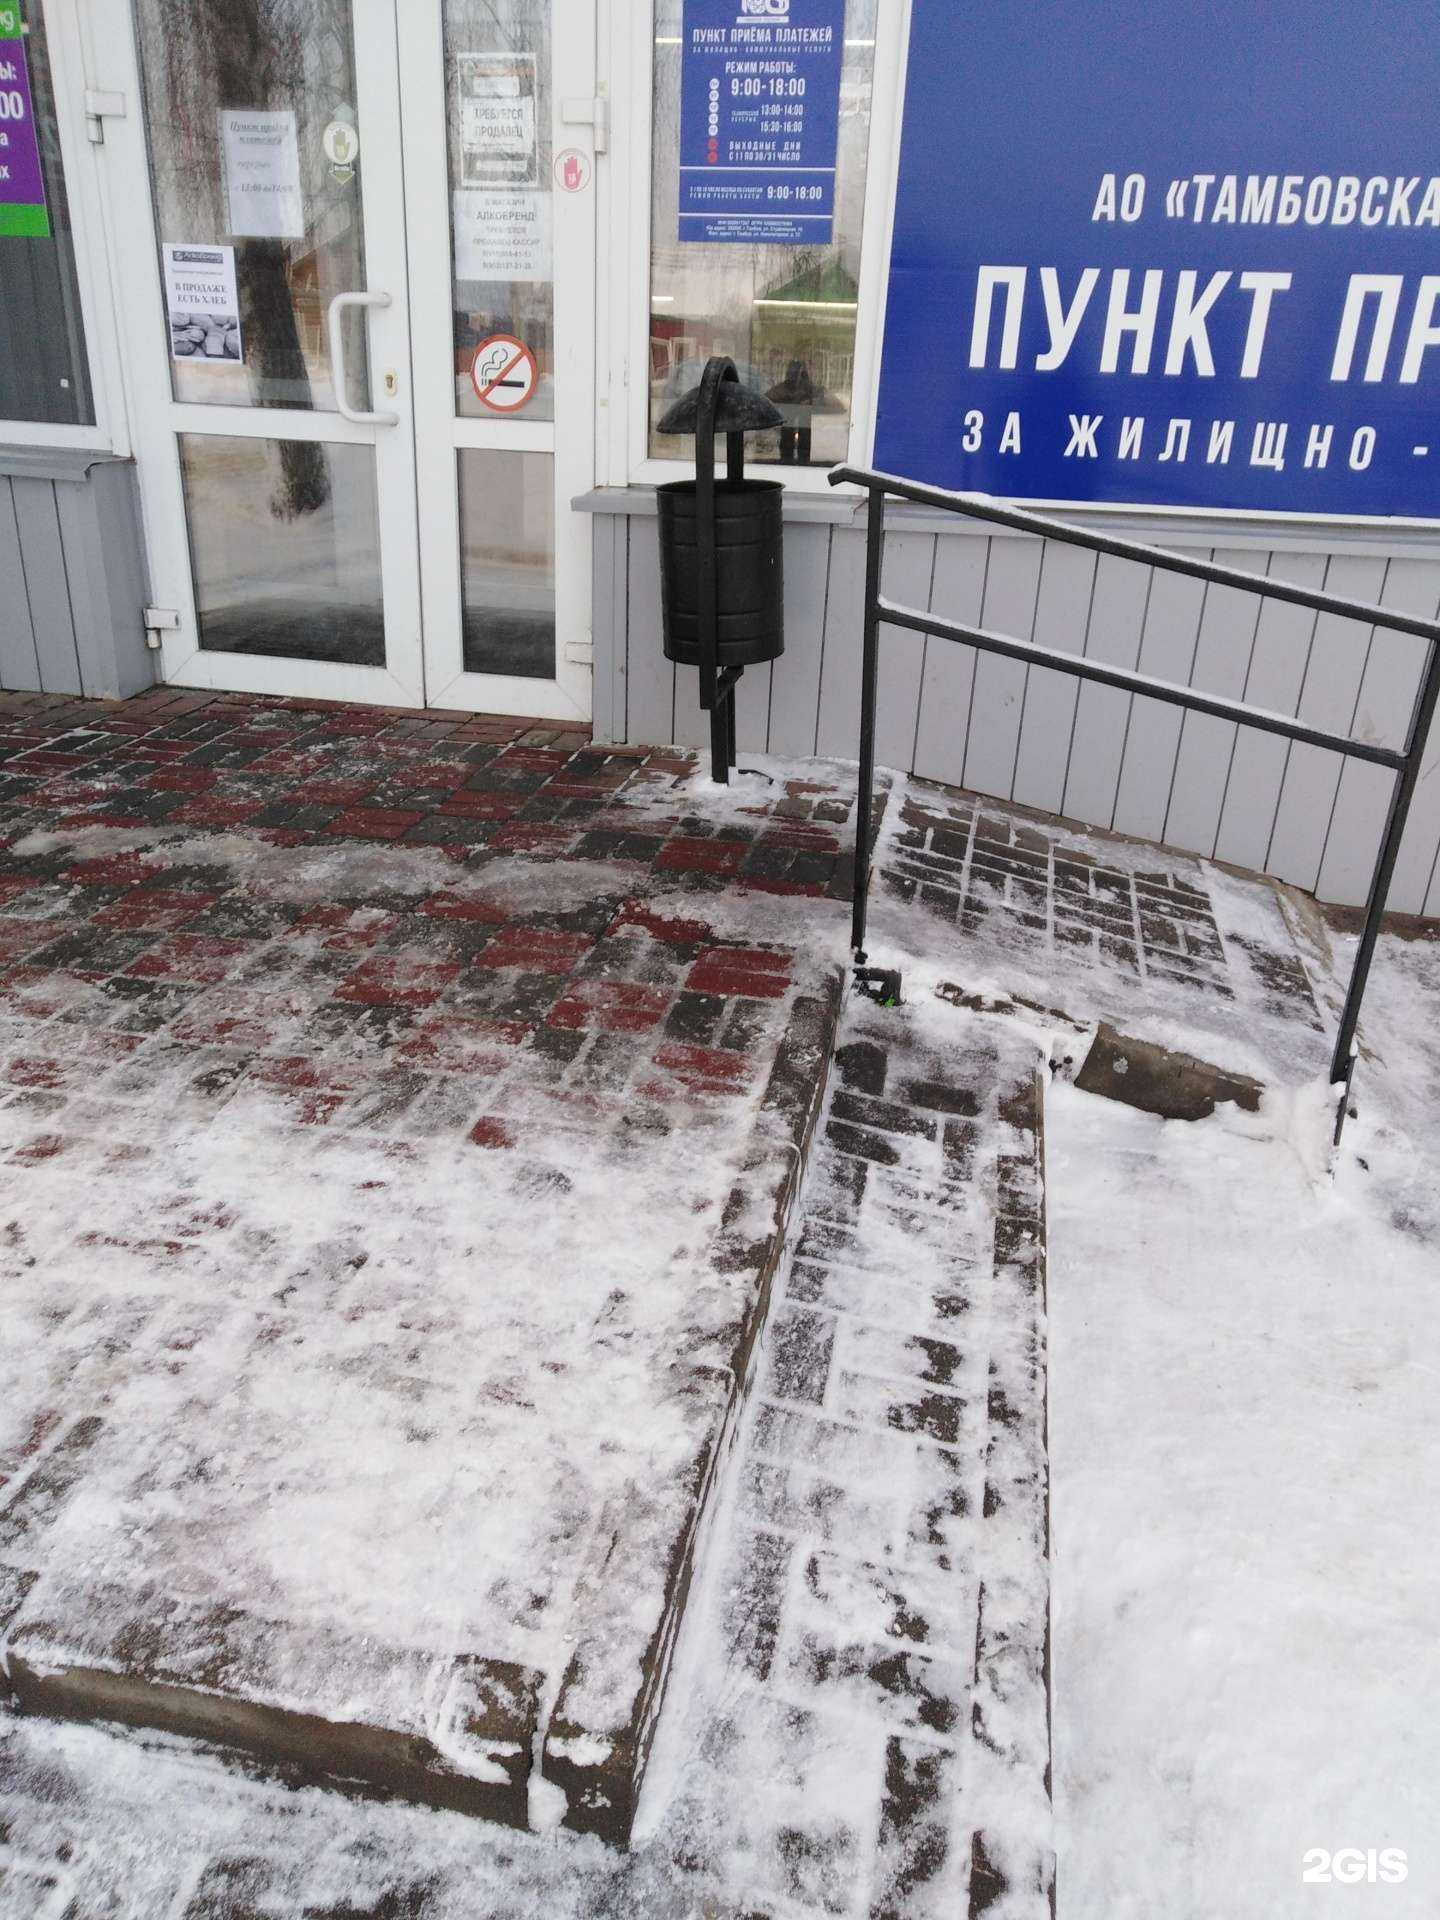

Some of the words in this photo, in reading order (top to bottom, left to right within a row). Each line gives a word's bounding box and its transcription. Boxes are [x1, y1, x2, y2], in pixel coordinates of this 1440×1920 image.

[692, 28, 725, 43] ПУНКТ
[731, 26, 771, 43] ПРИЁМА
[775, 25, 833, 43] ПЛАТЕЖЕЙ
[726, 61, 757, 74] РЕЖИМ
[759, 61, 798, 75] РАБОТЫ:
[729, 141, 776, 151] ВЫХОДНЫЕ
[783, 141, 802, 152] ДНИ
[777, 152, 801, 162] ЧИСЛО
[1091, 173, 1146, 222] АО
[1166, 174, 1440, 226] «ТАМБОВСКА
[183, 283, 227, 295] ПРОДАЖЕ
[968, 265, 1293, 379] ПУНКТ
[961, 410, 1021, 455] ЗА
[1064, 414, 1377, 472] ЖИЛИЩНО
